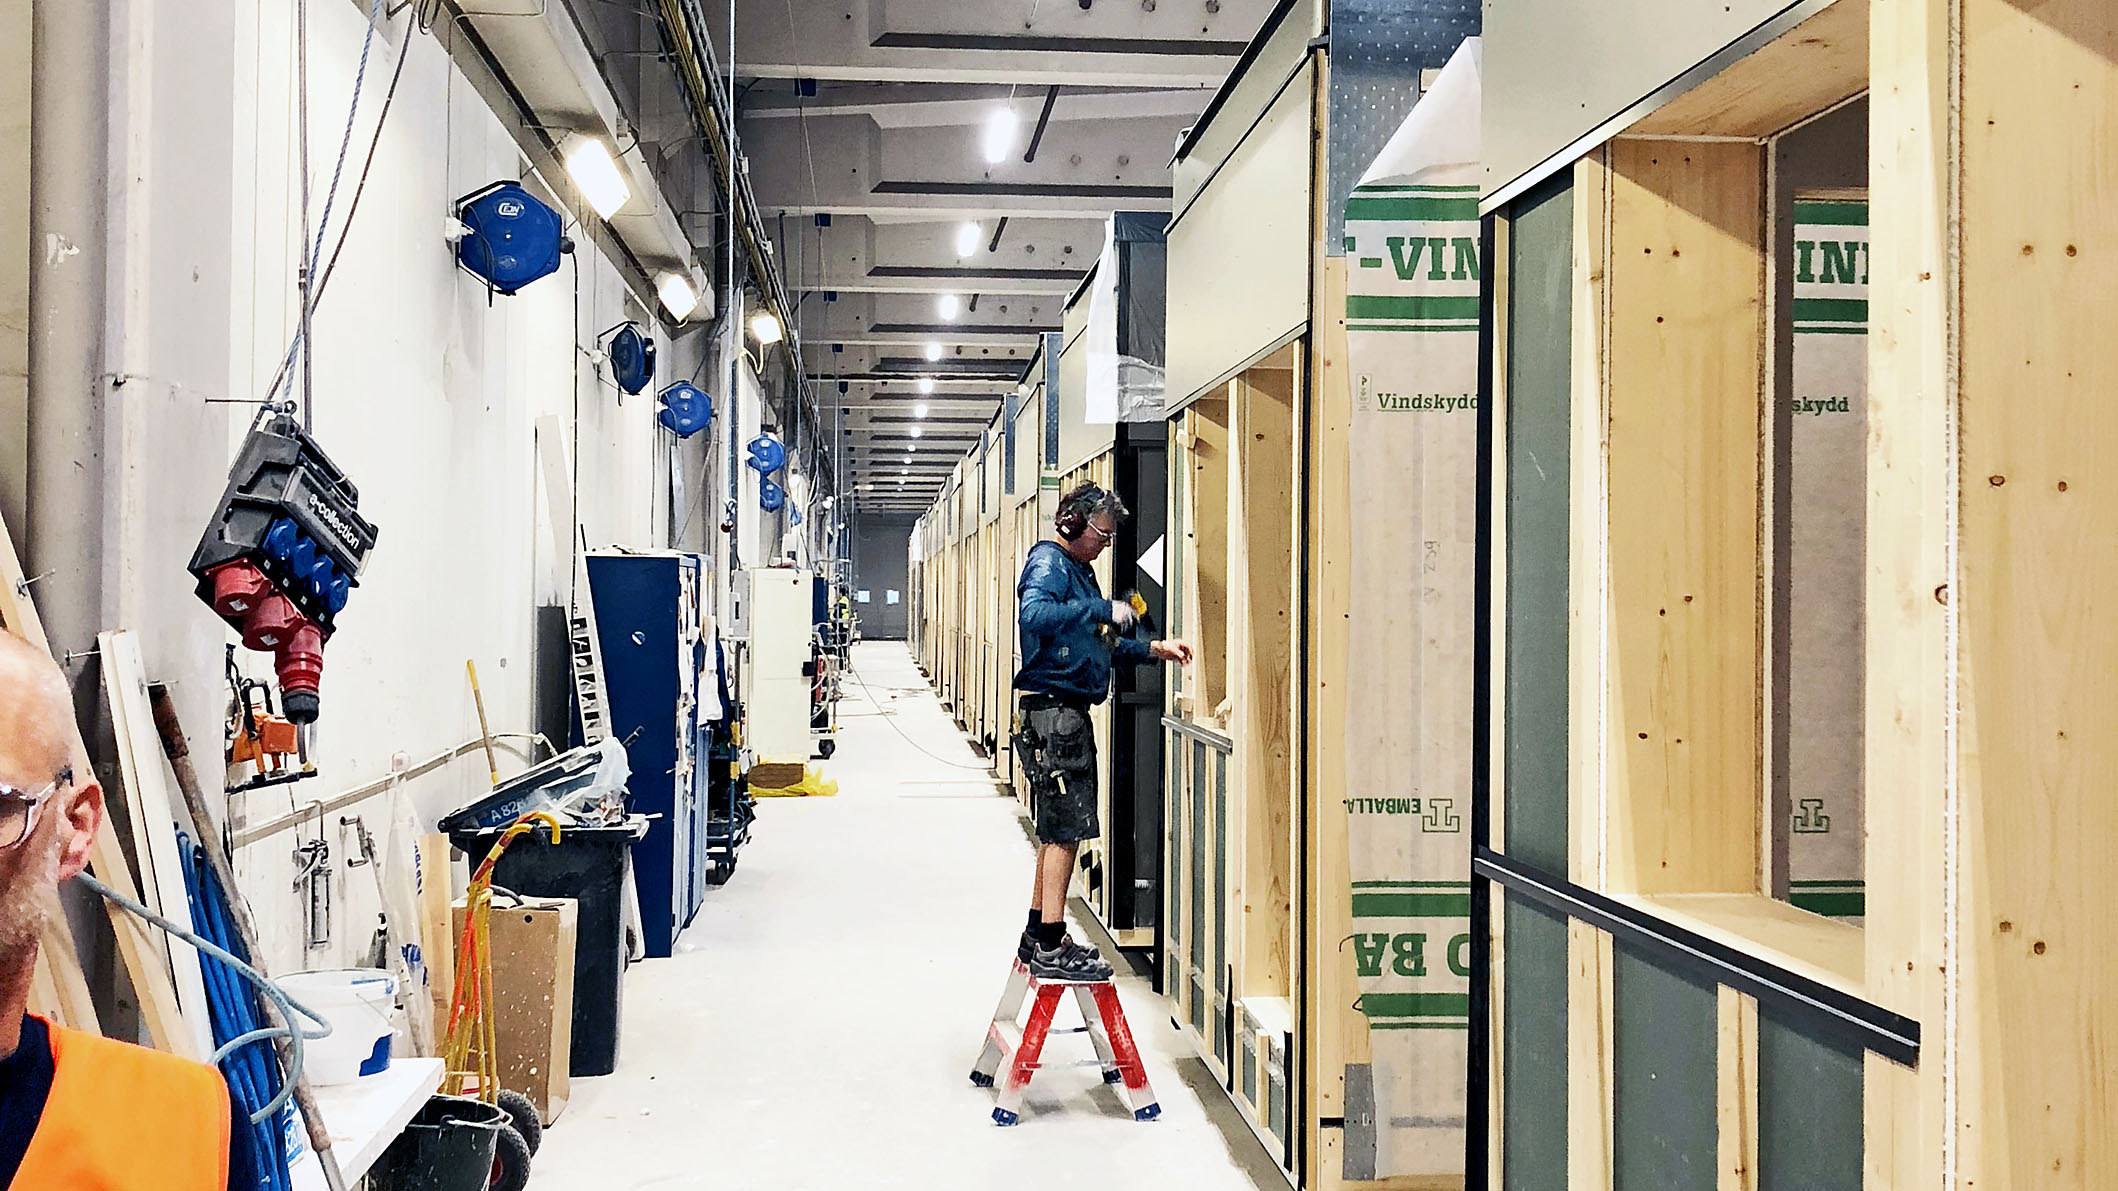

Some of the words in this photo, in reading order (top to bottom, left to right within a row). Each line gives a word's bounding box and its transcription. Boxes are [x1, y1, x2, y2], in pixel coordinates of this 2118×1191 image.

[1343, 236, 1480, 281] -VIN
[1791, 396, 1850, 417] skydd
[1346, 798, 1421, 815] EMBALLA
